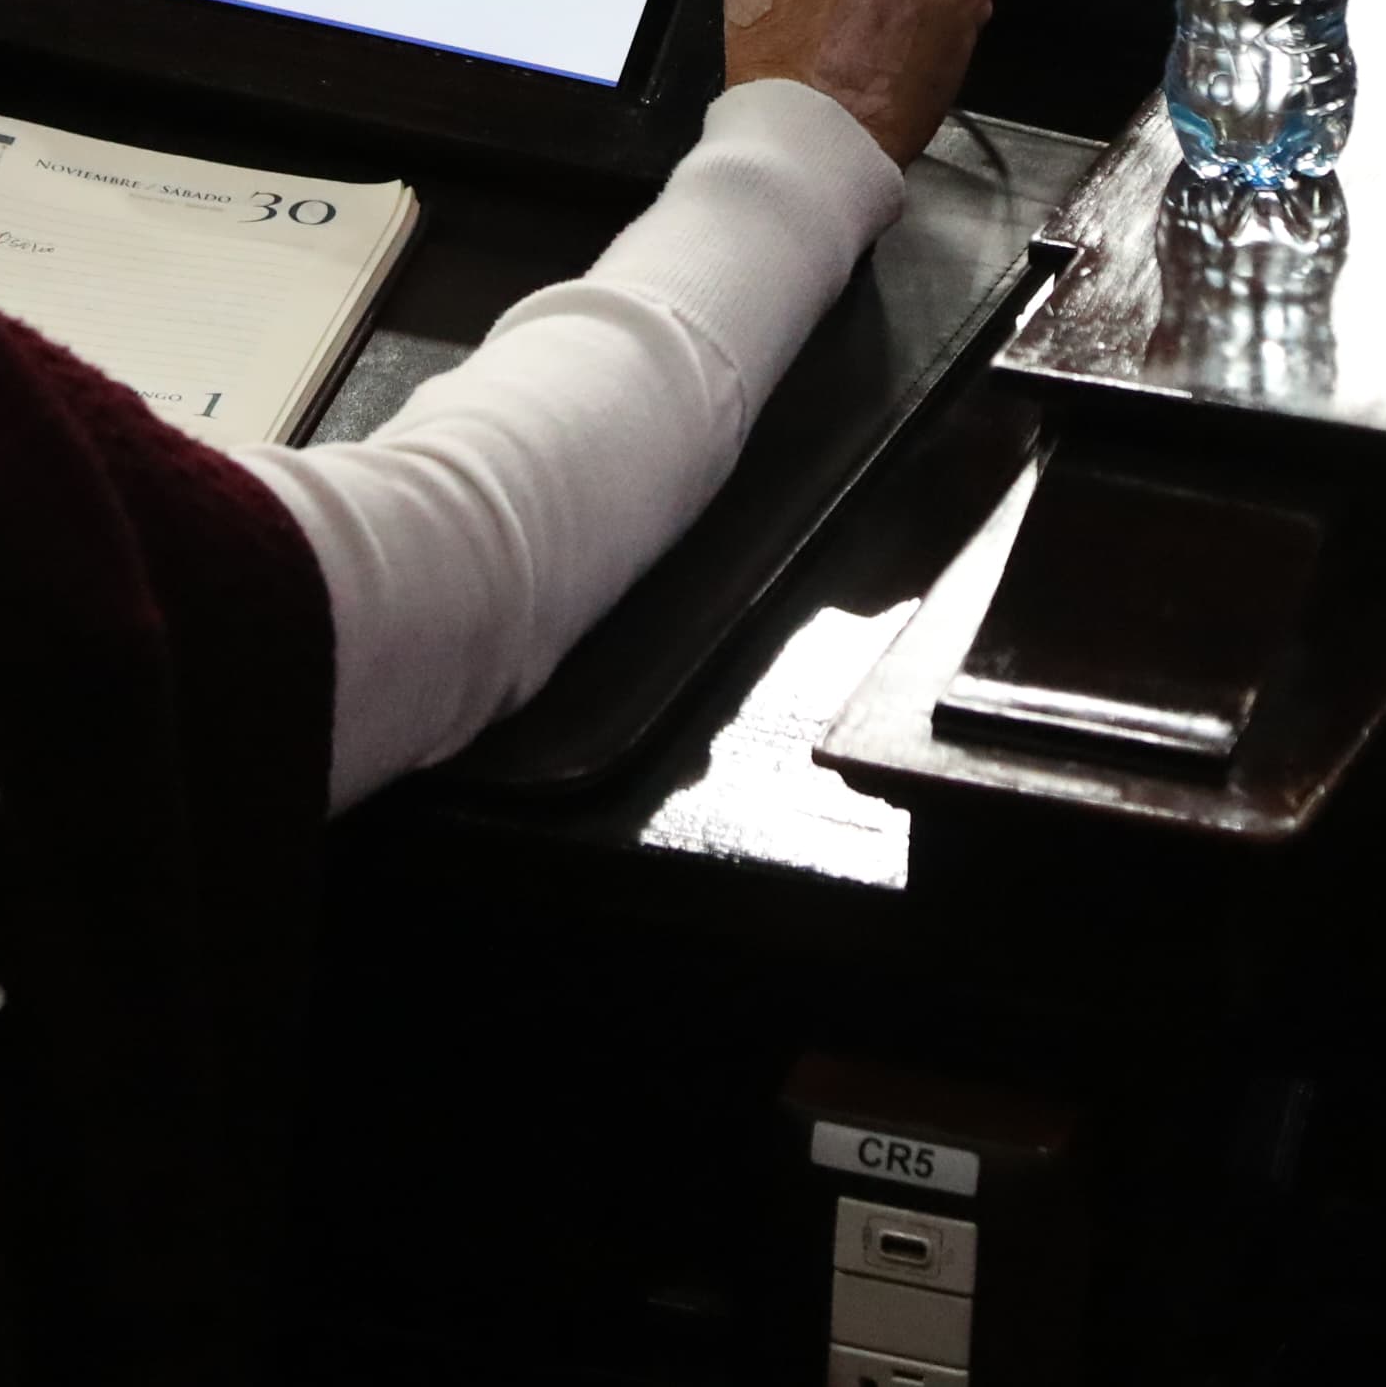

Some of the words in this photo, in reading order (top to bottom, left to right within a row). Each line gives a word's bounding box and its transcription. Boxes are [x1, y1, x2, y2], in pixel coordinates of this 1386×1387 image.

[35, 158, 141, 190] NOVIEMBRE
[161, 183, 232, 205] SÁBADO
[237, 190, 337, 226] 30
[193, 392, 222, 420] 1
[857, 1136, 936, 1180] CR5
